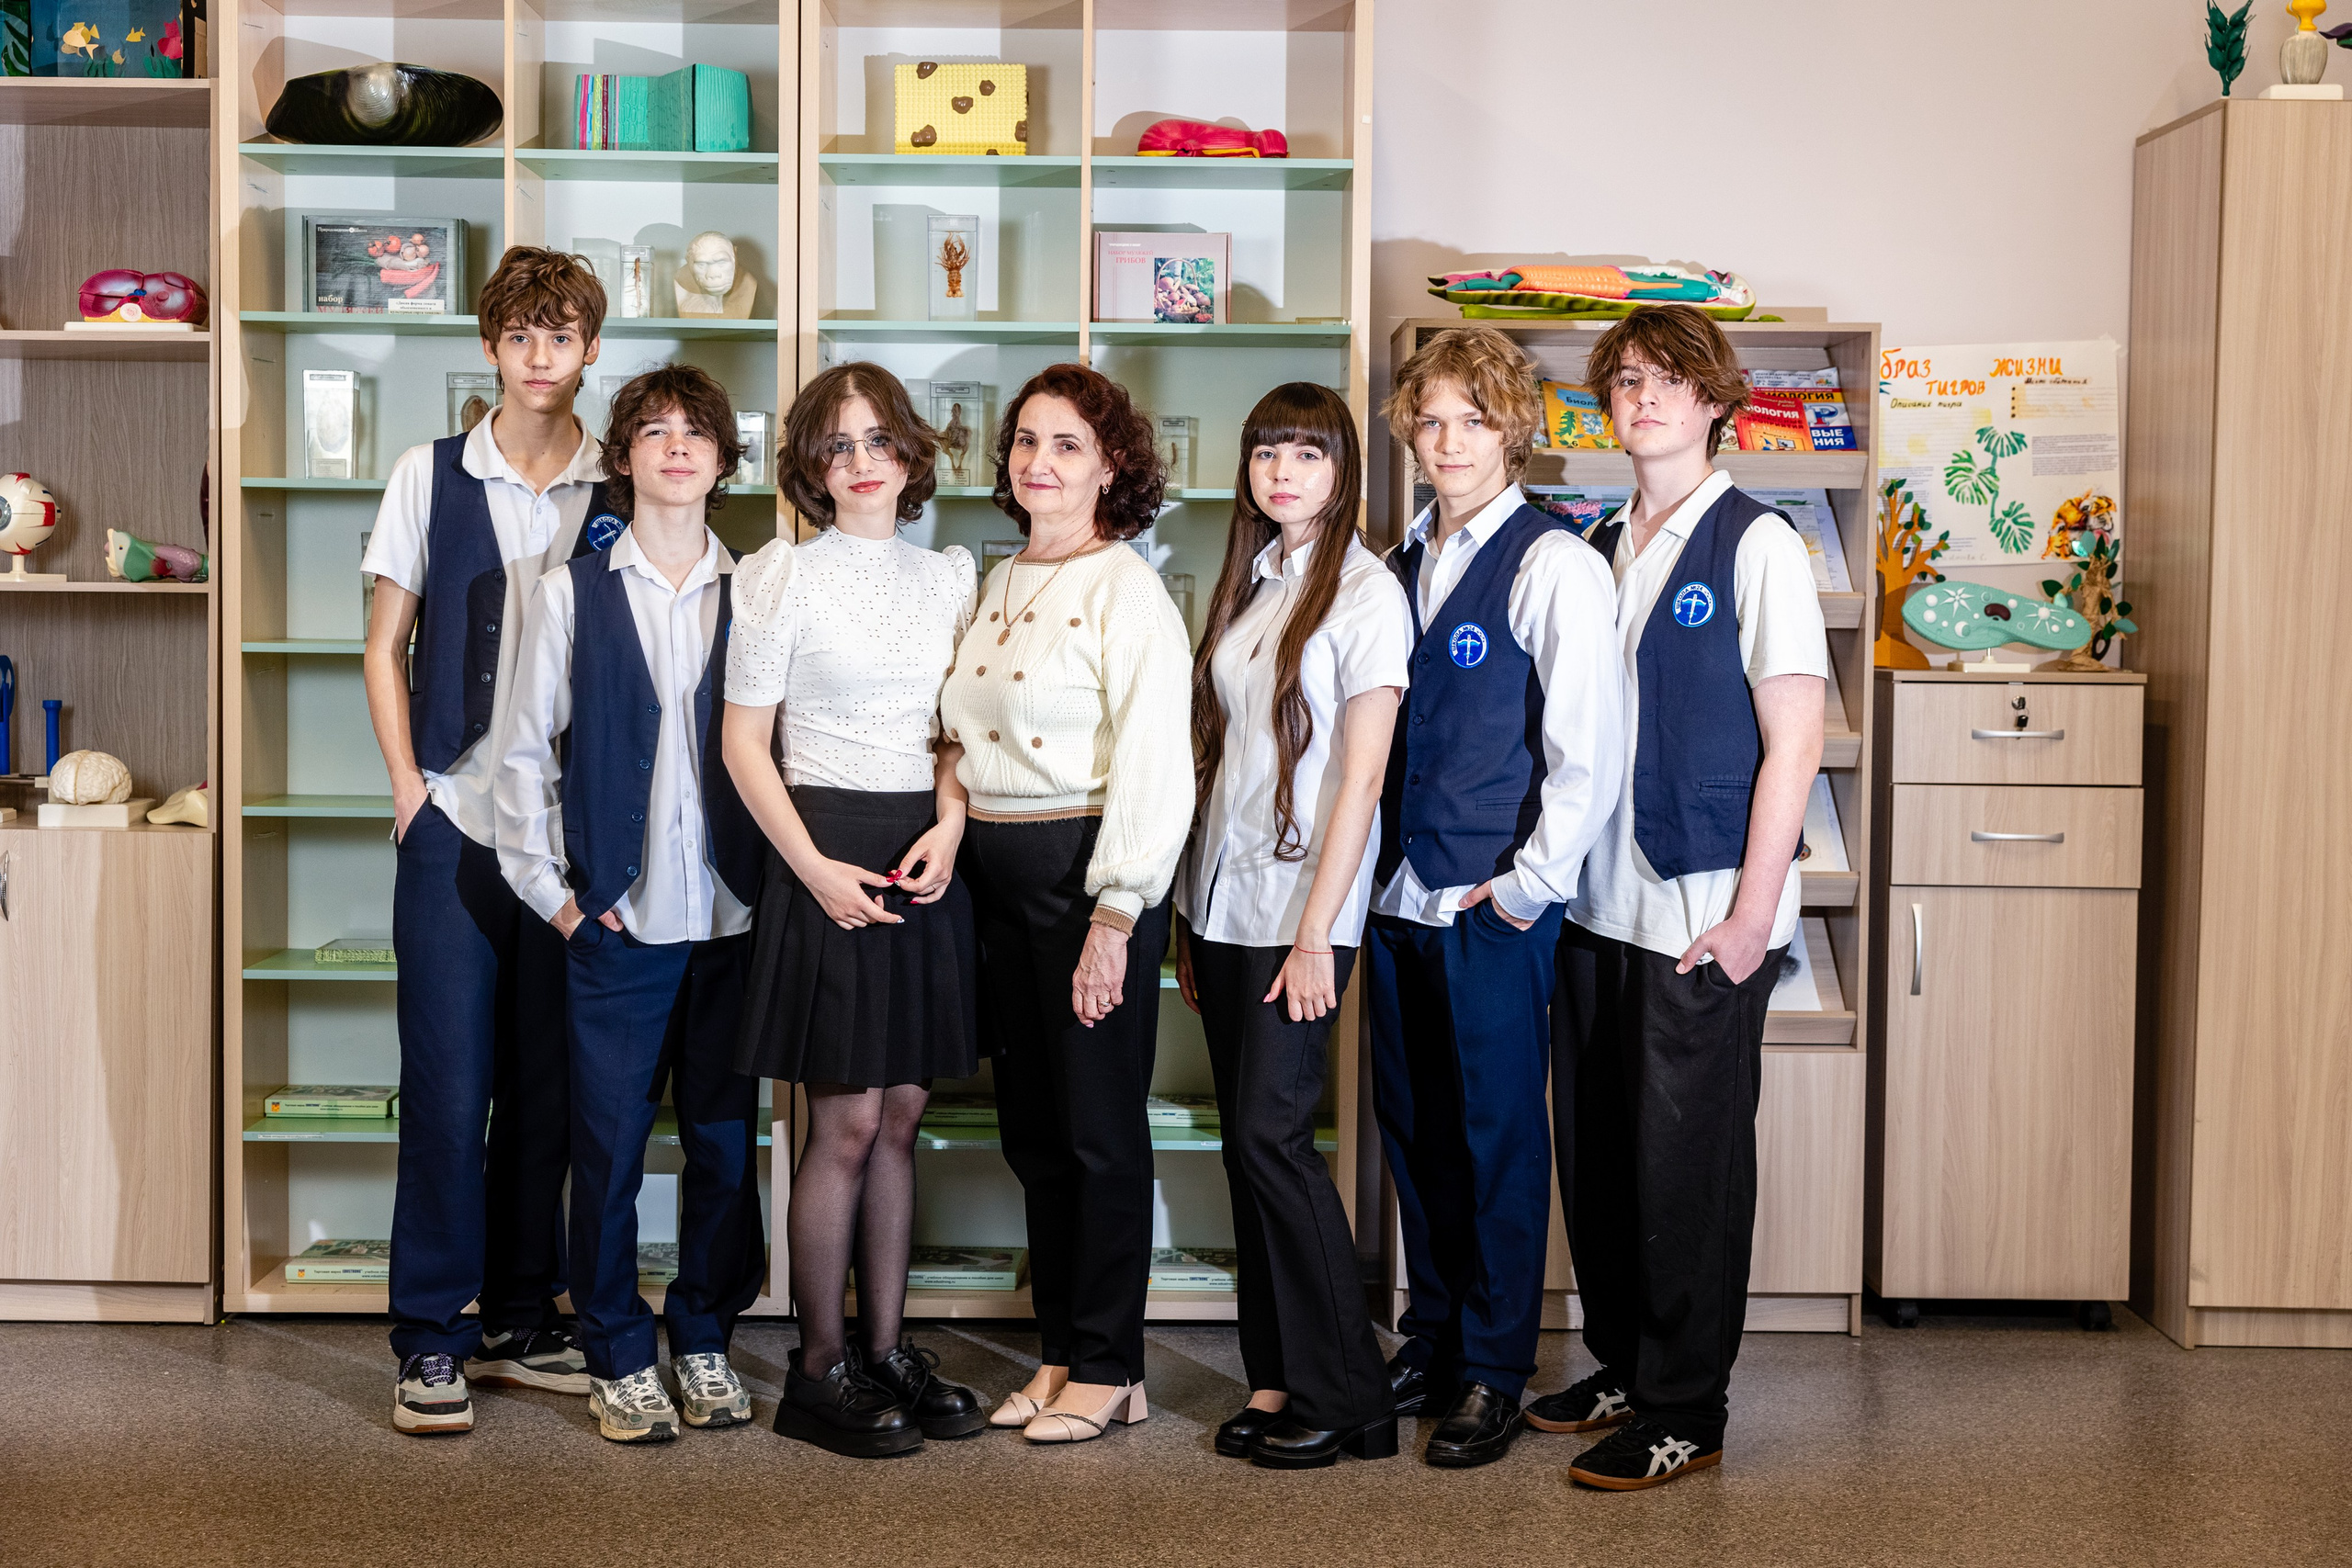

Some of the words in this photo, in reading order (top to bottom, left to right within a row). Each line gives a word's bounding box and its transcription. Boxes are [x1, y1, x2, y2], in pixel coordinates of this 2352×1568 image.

[318, 294, 344, 304] набор
[1880, 348, 1931, 379] браз
[1675, 588, 1690, 610] ШКОЛА
[1452, 629, 1463, 651] ШКОЛА
